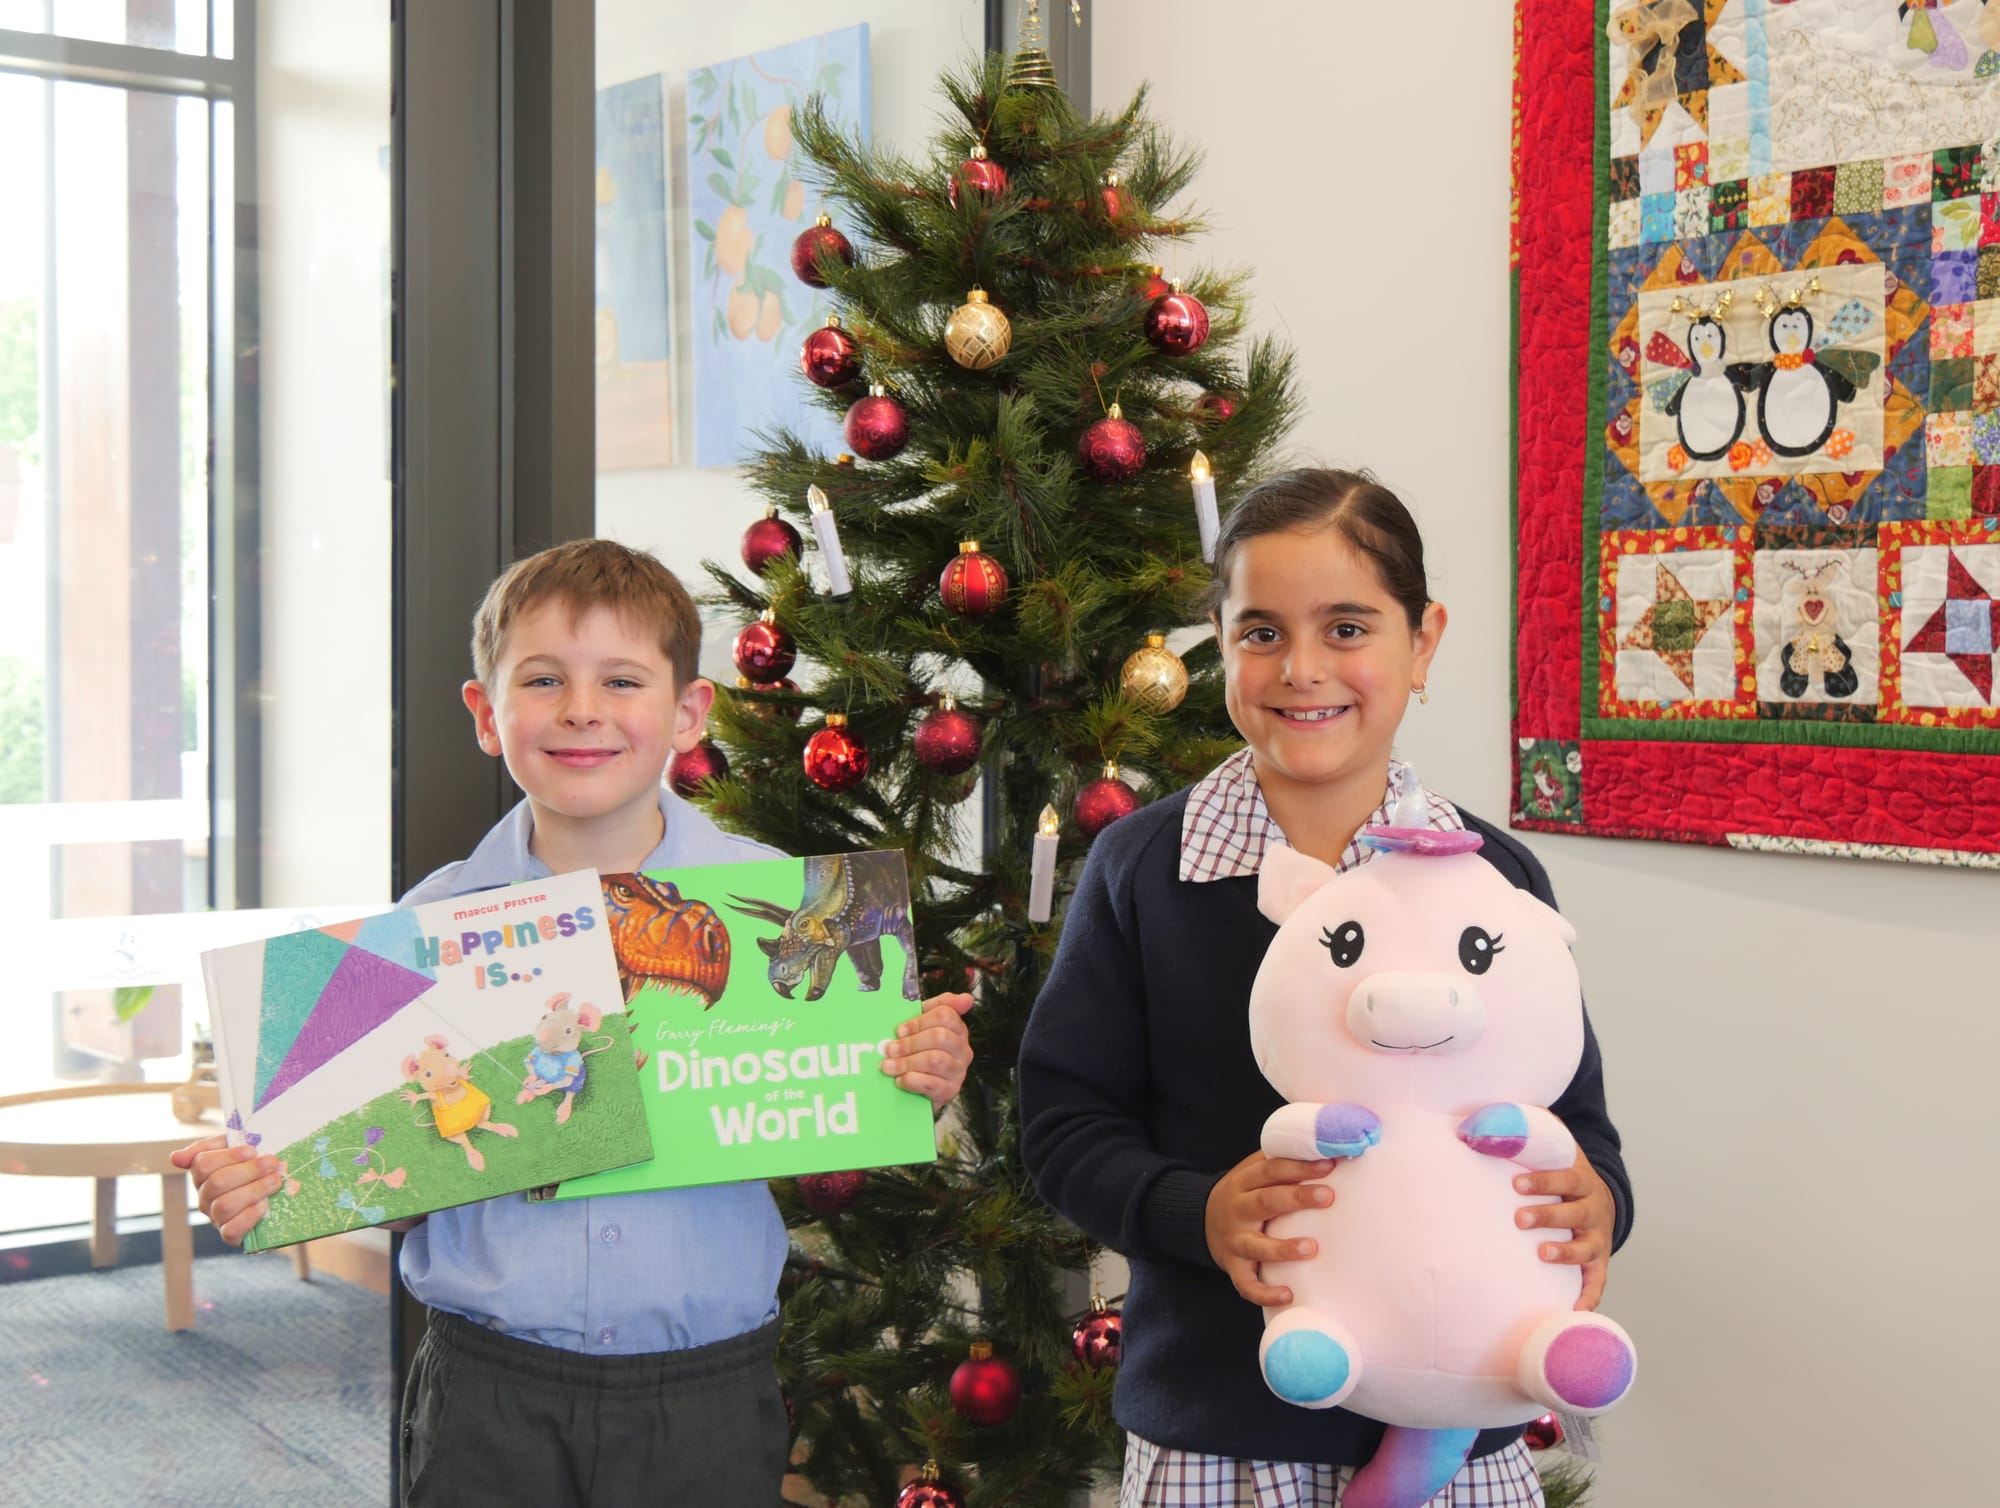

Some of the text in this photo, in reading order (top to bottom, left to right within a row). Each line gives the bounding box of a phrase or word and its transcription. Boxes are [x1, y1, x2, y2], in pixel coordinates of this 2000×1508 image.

[656, 1017, 797, 1048] Garry Fleming's
[764, 1089, 805, 1103] of the
[710, 1091, 859, 1147] World
